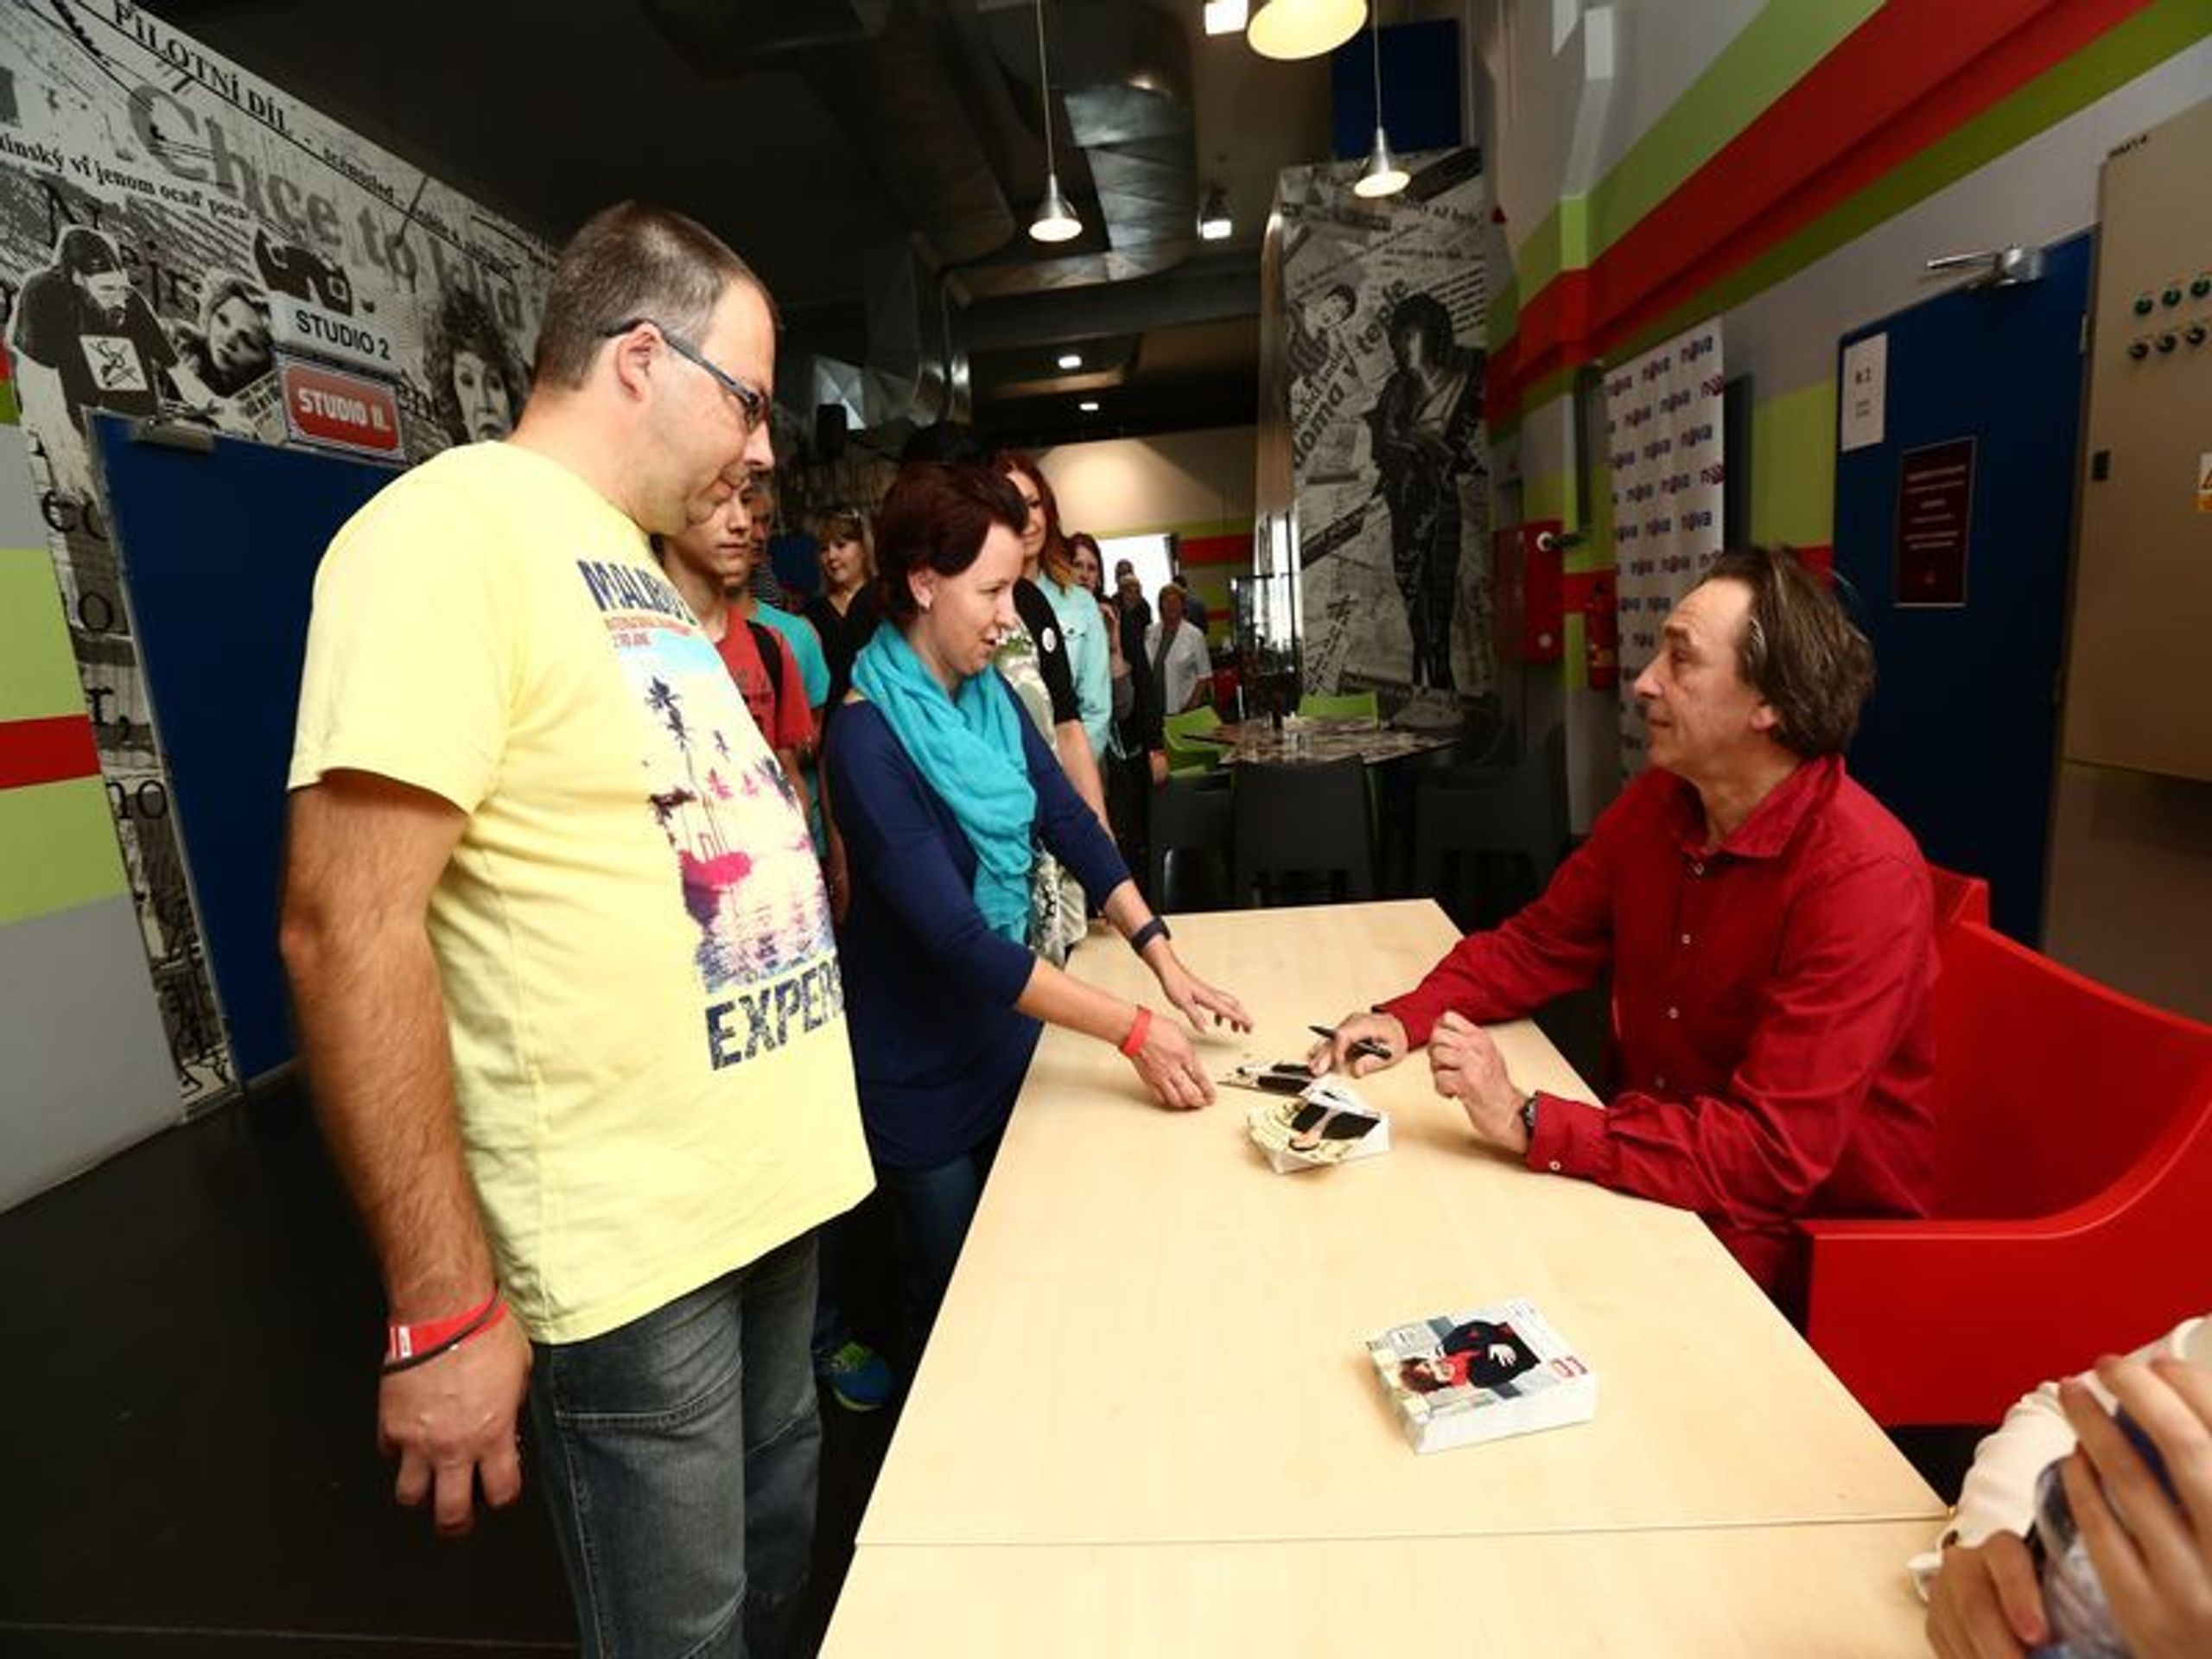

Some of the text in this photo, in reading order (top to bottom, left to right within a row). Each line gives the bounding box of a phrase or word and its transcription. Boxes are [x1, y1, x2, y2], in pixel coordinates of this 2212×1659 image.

[295, 309, 391, 360] STUDIO 2
[298, 387, 368, 426] STUDIO
